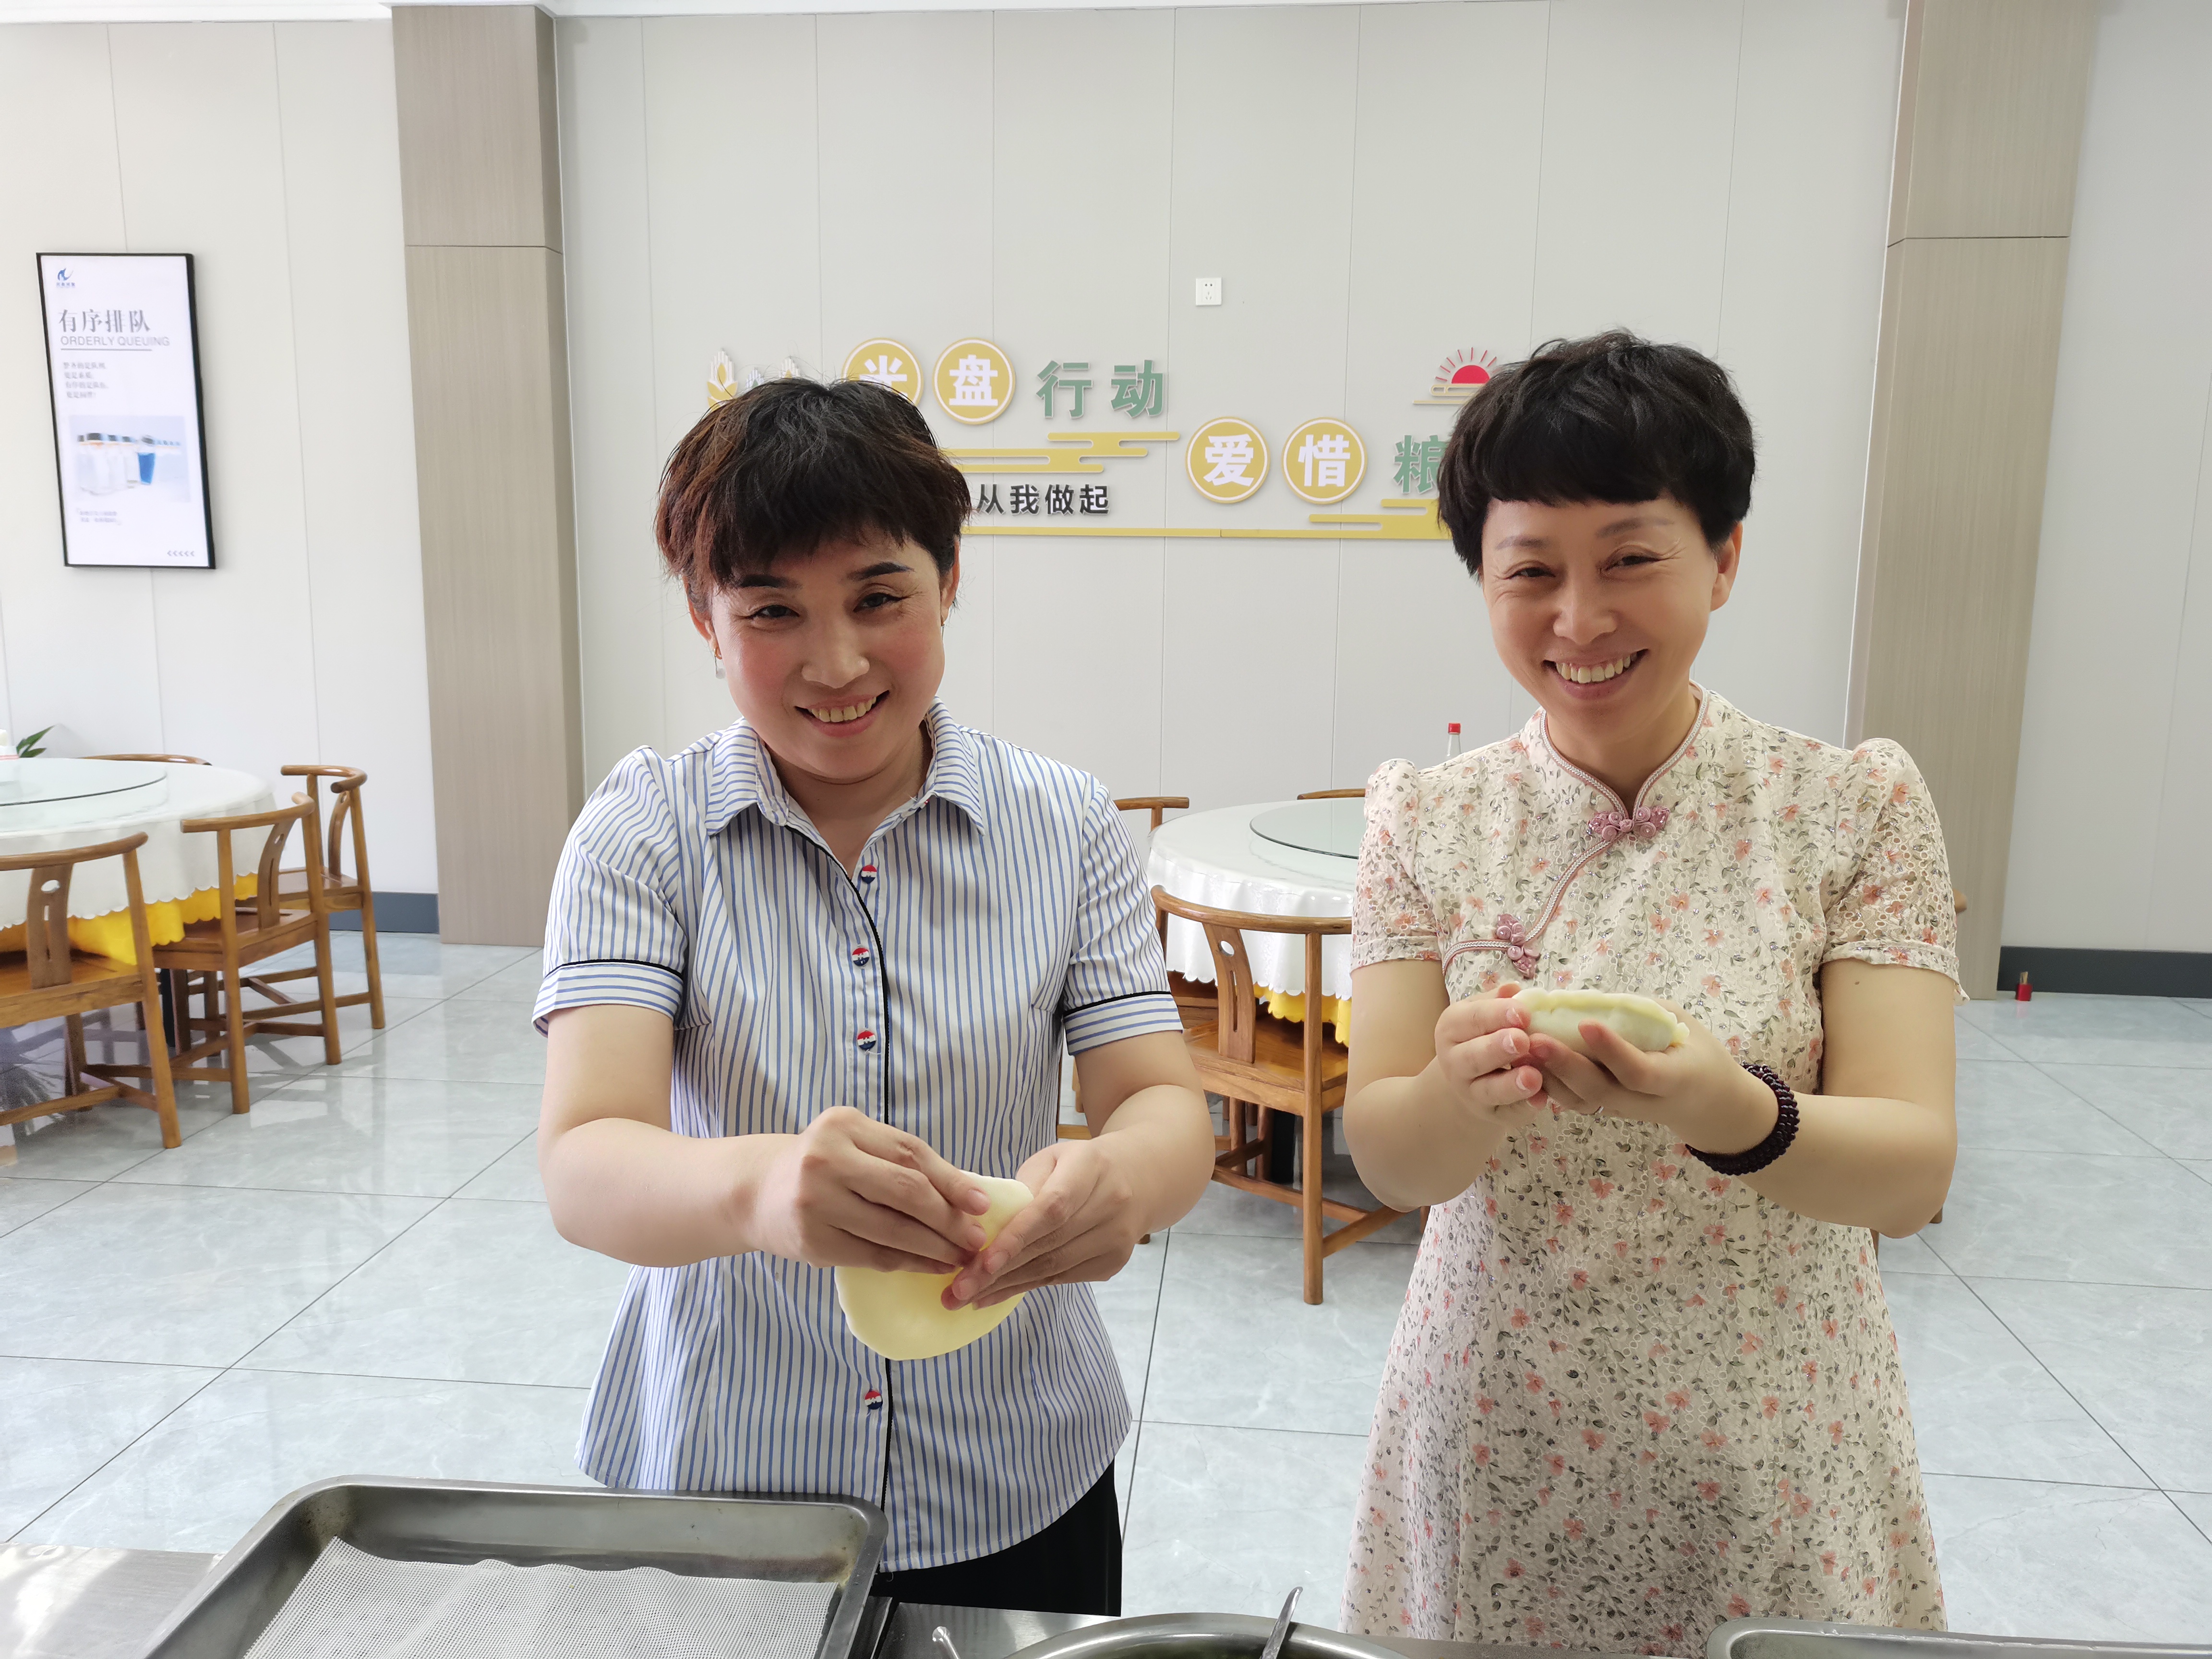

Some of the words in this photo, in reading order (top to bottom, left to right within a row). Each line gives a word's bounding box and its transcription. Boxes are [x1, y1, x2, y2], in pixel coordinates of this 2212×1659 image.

[59, 309, 150, 333] 有序排队
[60, 336, 116, 346] ORDERLY
[976, 483, 1110, 516] 从我做起
